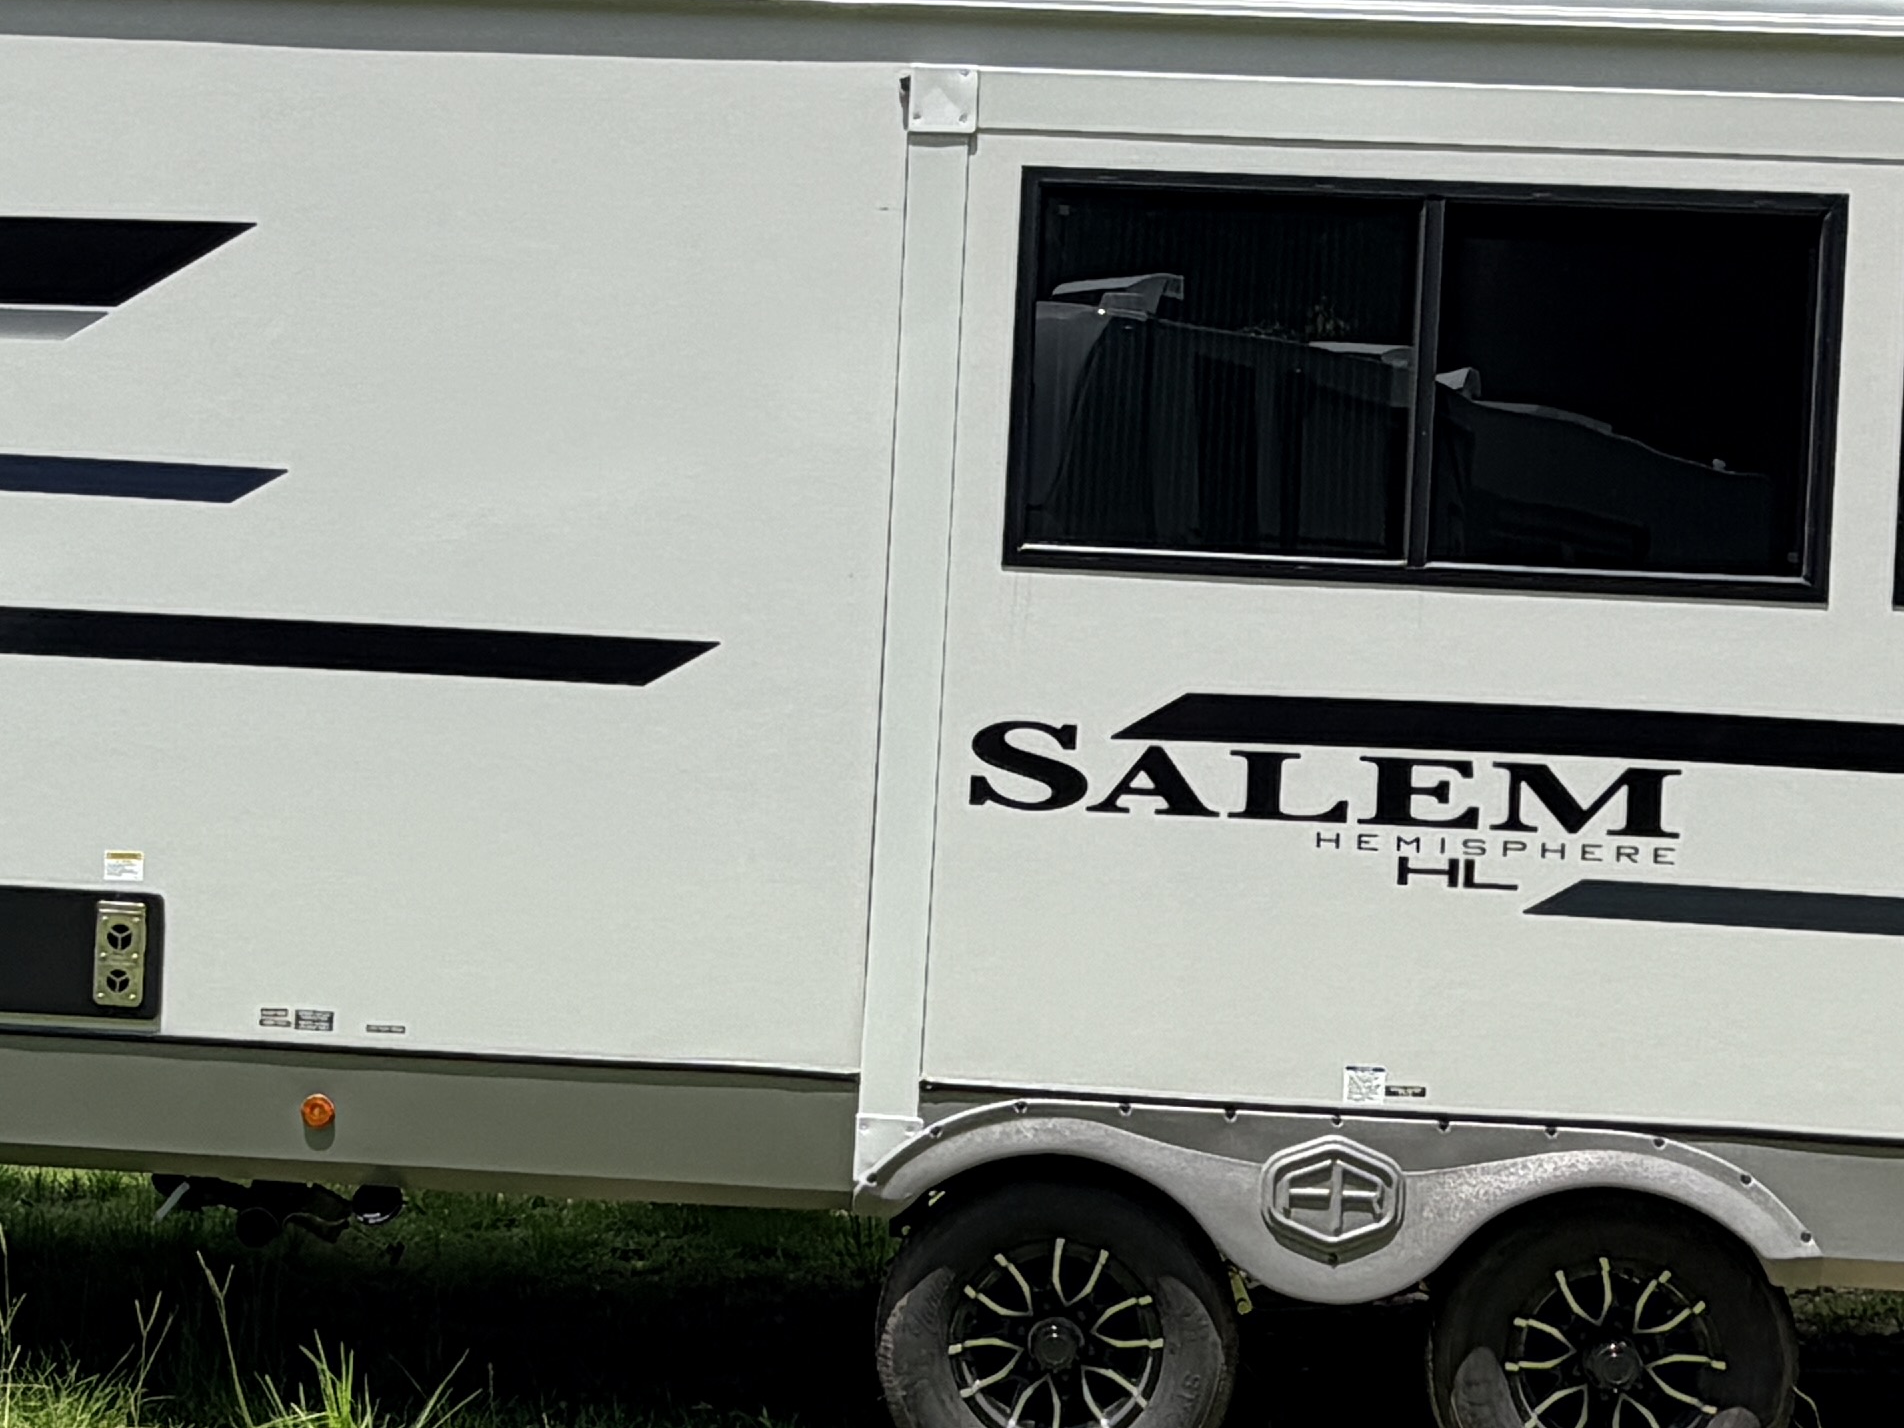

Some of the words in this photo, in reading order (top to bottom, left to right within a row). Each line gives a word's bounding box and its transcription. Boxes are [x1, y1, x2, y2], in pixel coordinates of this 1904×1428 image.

[969, 721, 1682, 839] SALEM
[1316, 831, 1676, 866] HEMISPHERE
[1396, 856, 1518, 890] HL
